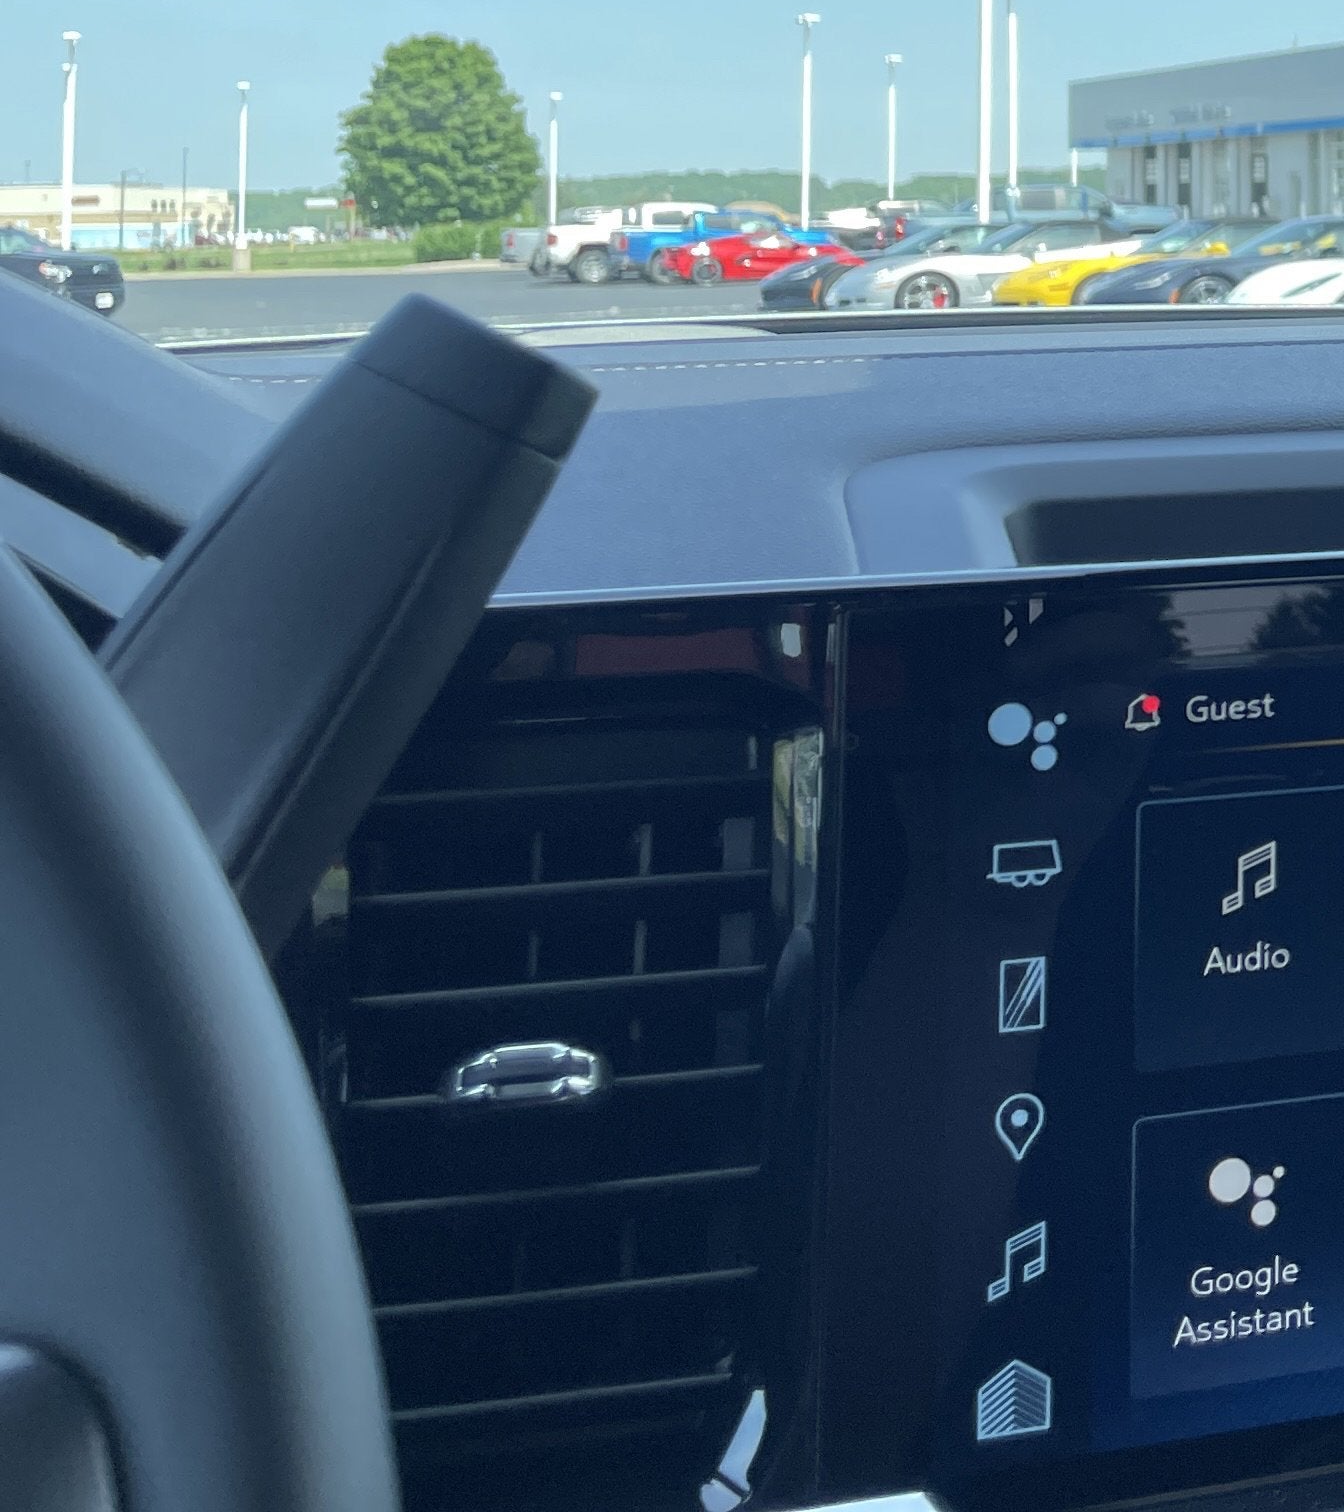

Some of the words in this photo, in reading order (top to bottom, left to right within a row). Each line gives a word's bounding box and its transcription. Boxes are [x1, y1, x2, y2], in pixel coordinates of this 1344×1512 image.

[1185, 692, 1276, 723] Guest
[1203, 940, 1291, 976] Audio
[1191, 1255, 1300, 1297] Google
[1172, 1301, 1315, 1348] Assistant
